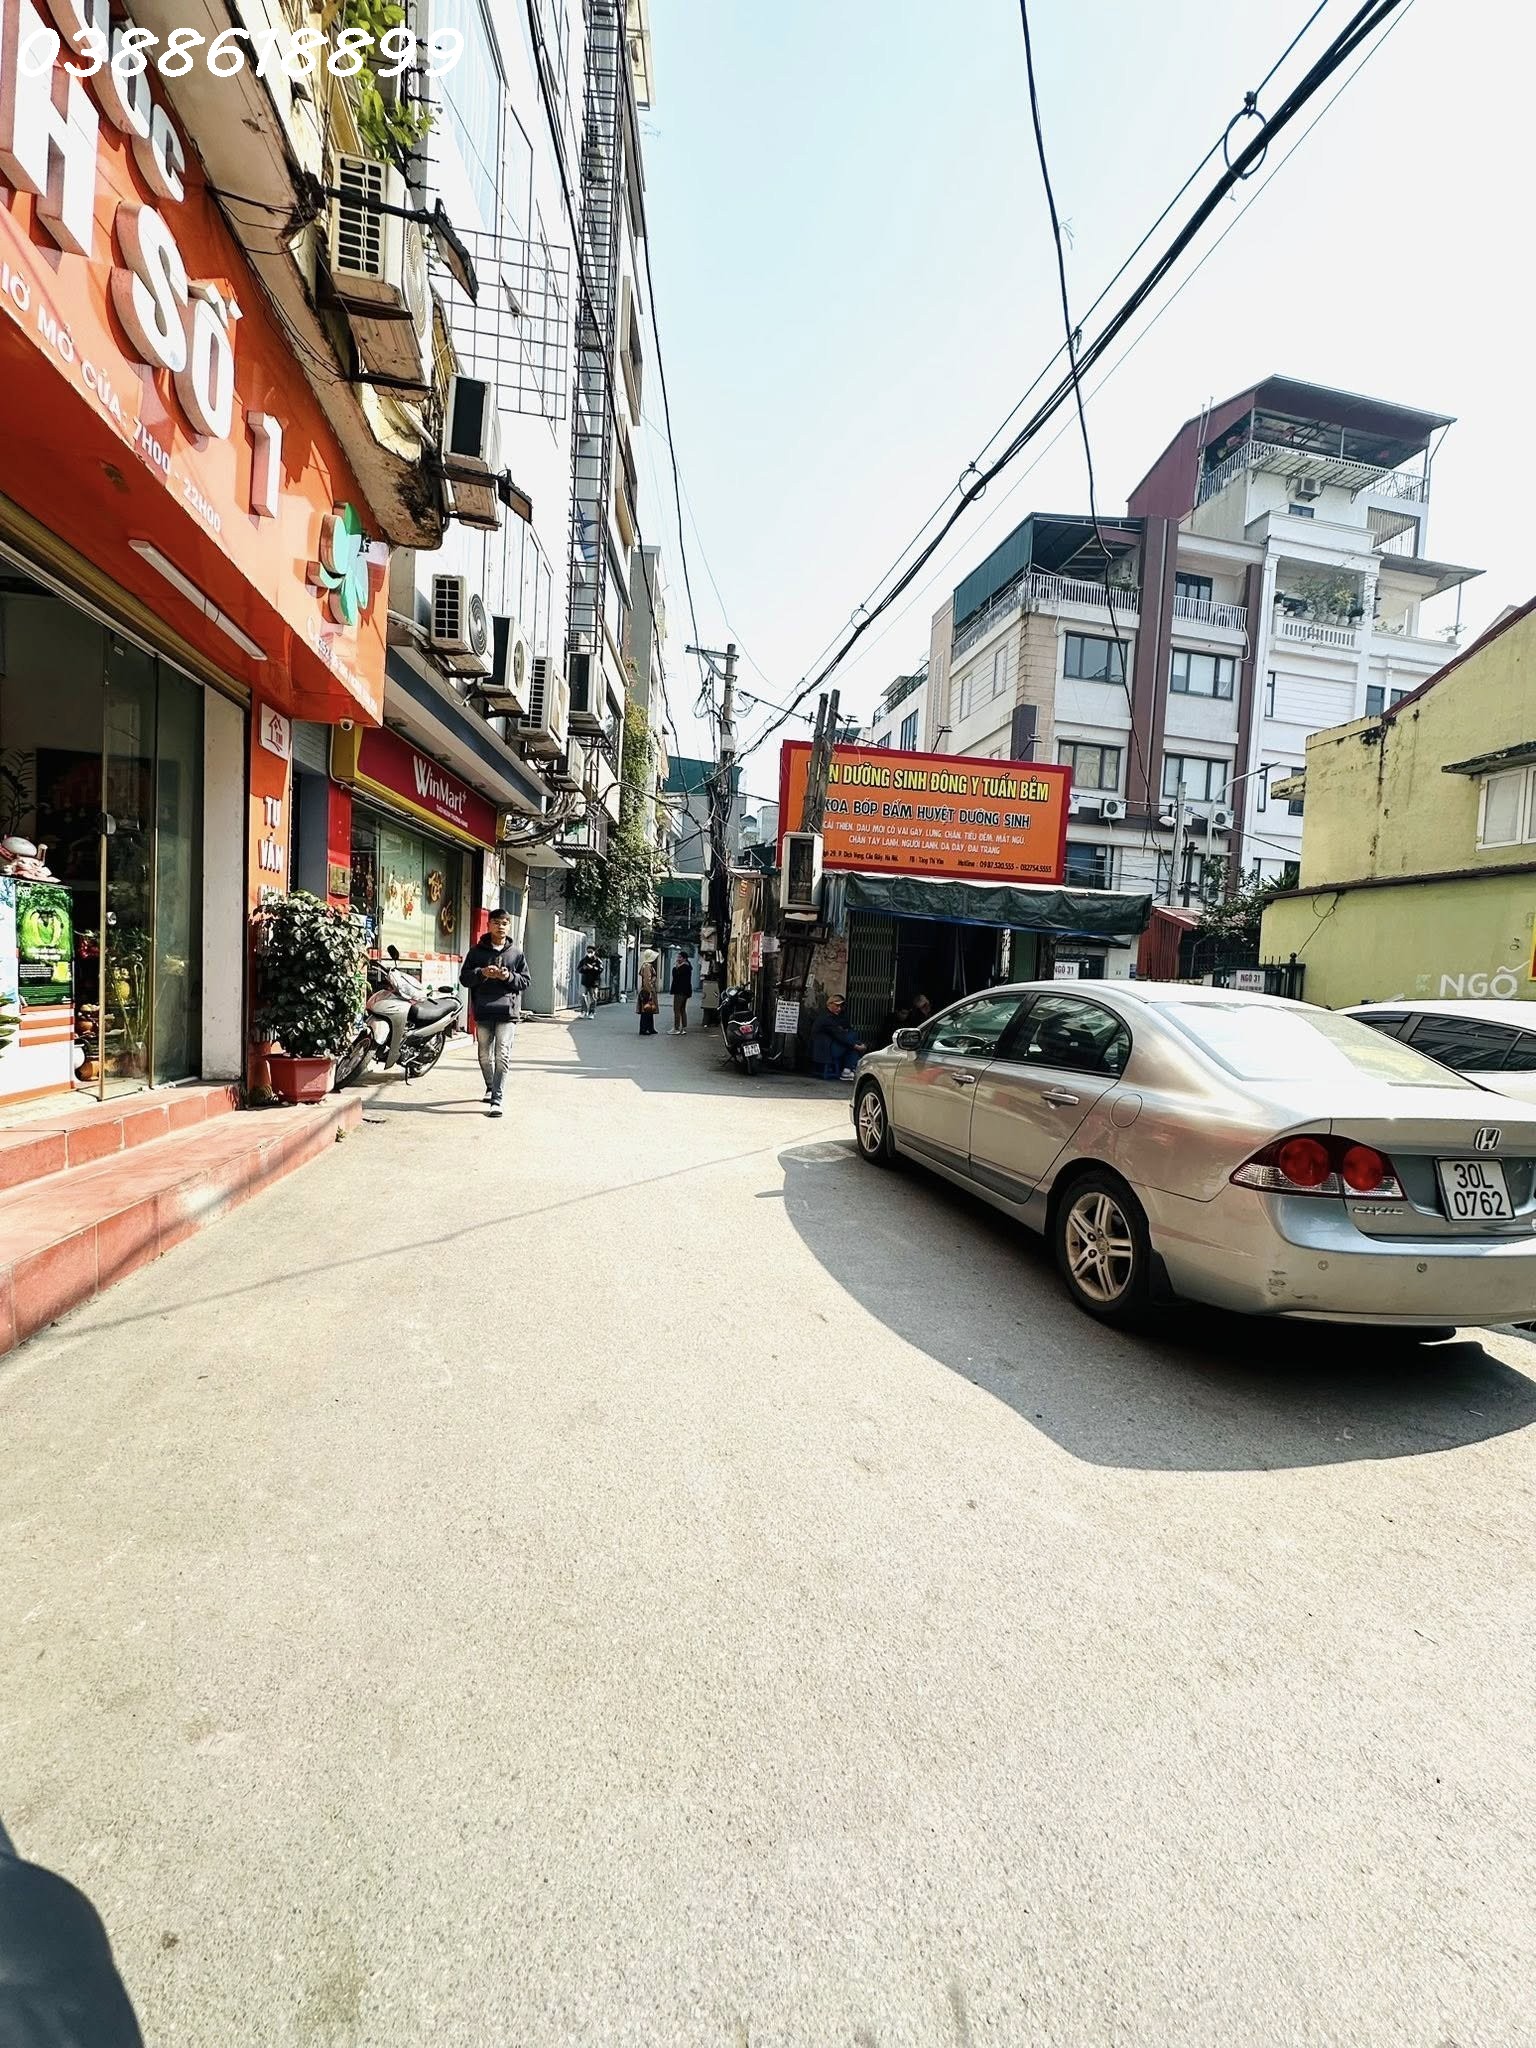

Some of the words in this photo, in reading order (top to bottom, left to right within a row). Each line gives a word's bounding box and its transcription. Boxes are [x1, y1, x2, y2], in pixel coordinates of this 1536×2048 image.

[120, 203, 243, 441] SỐ
[133, 416, 172, 475] 7H00
[183, 479, 222, 533] 22H00
[842, 762, 890, 789] DƯỠNG
[893, 769, 928, 791] SINH
[930, 769, 967, 795] ĐÔNG
[971, 775, 980, 796] Y
[982, 772, 1017, 799] TUẤN
[1004, 813, 1031, 830] SINH
[1254, 974, 1261, 982] 31
[1439, 960, 1531, 999] NGÕ
[1454, 1163, 1494, 1189] 30L
[1453, 1191, 1507, 1217] 0762
